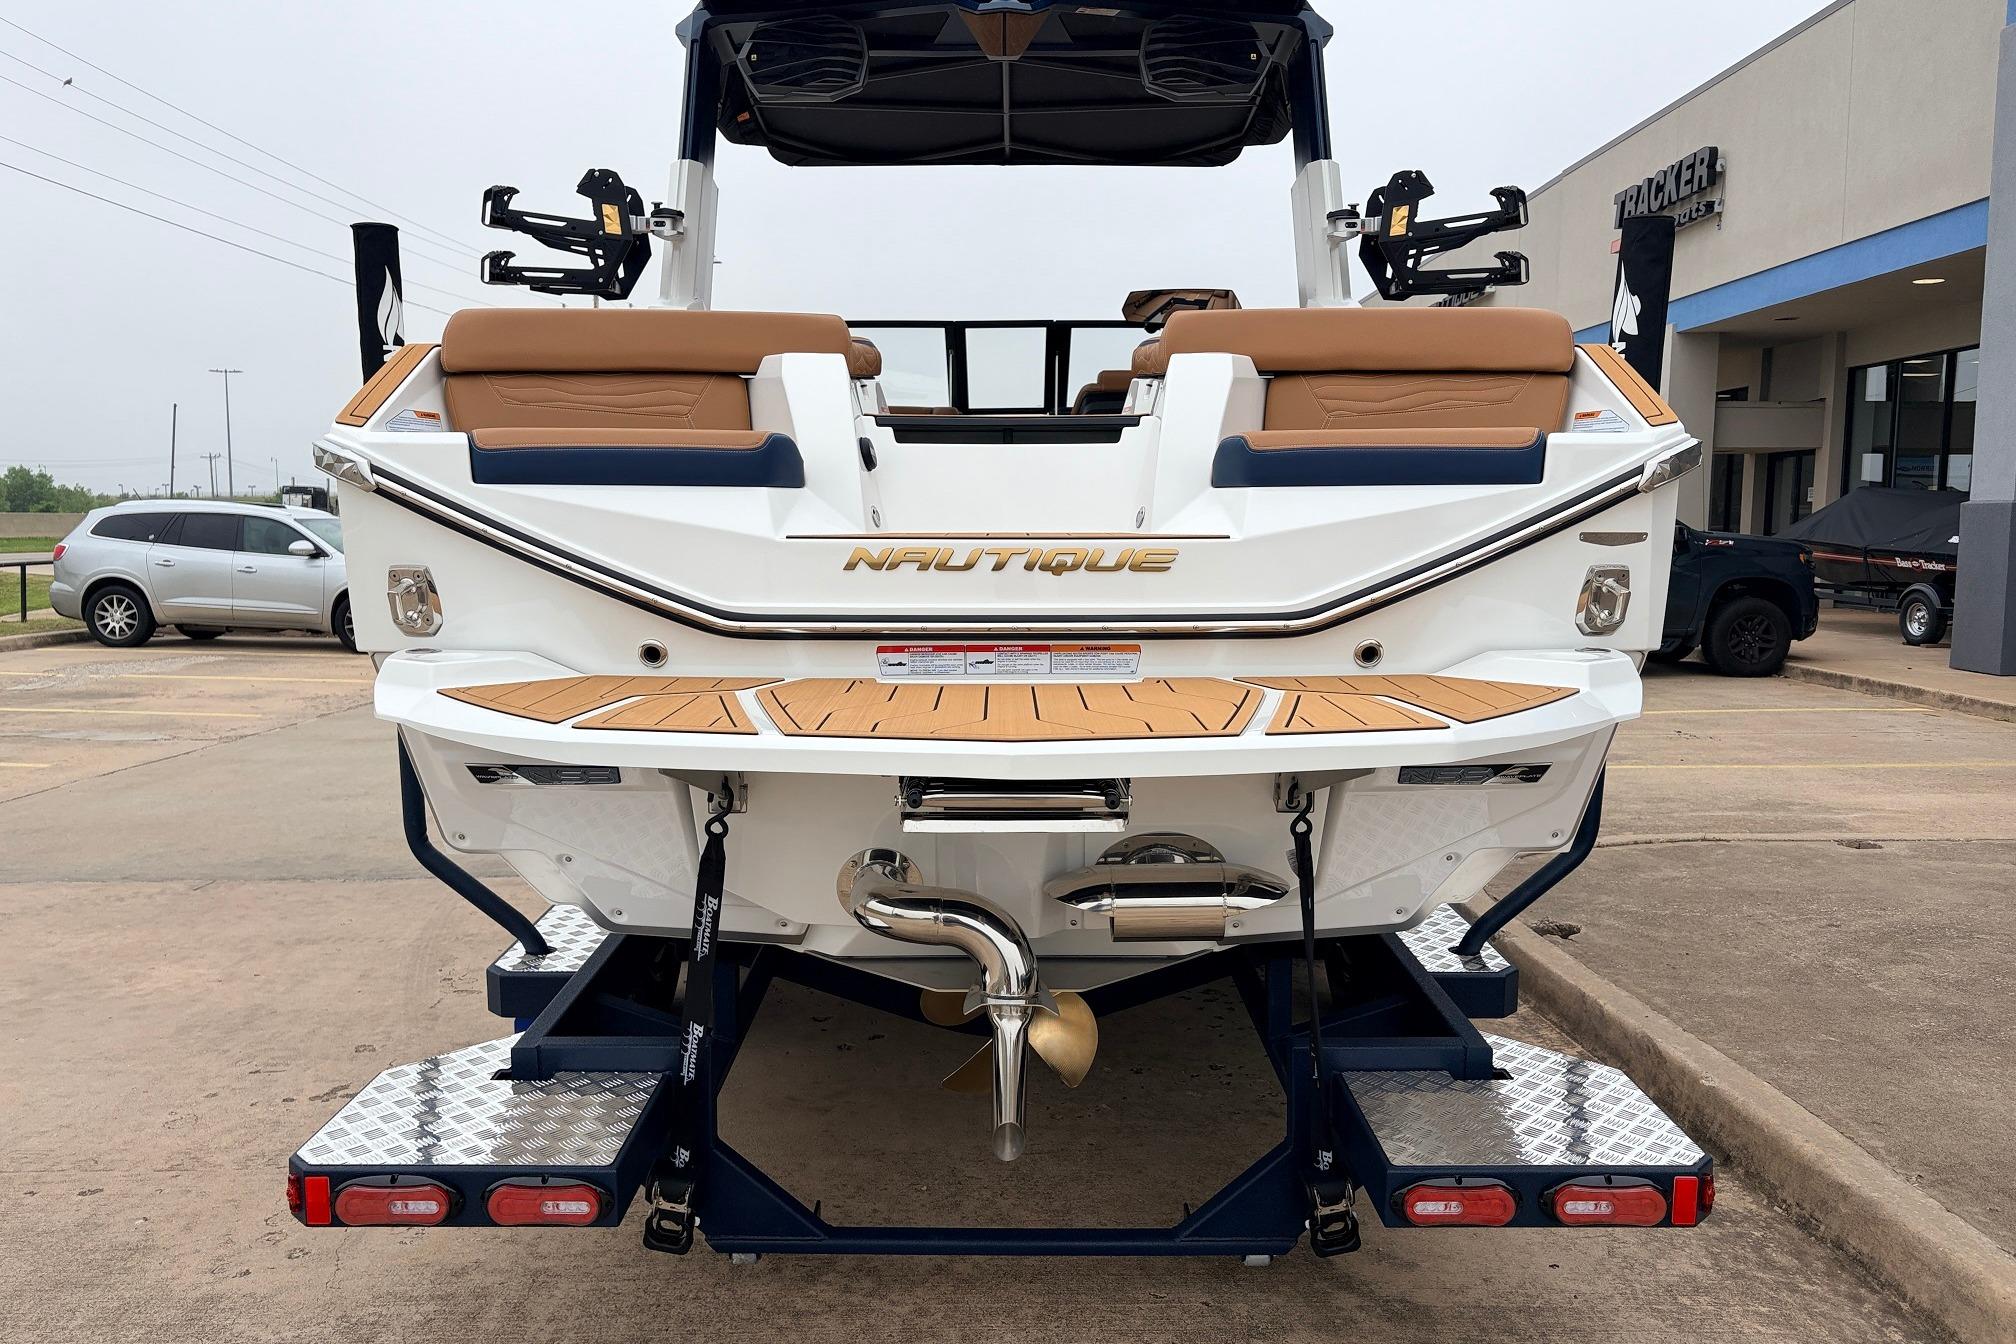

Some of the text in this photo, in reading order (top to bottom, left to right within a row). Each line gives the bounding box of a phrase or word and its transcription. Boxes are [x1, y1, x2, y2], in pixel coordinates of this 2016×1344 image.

[1613, 146, 1718, 229] TRACKER
[843, 547, 1179, 576] NAUTIQUE
[1895, 557, 1946, 571] Bass Tracker
